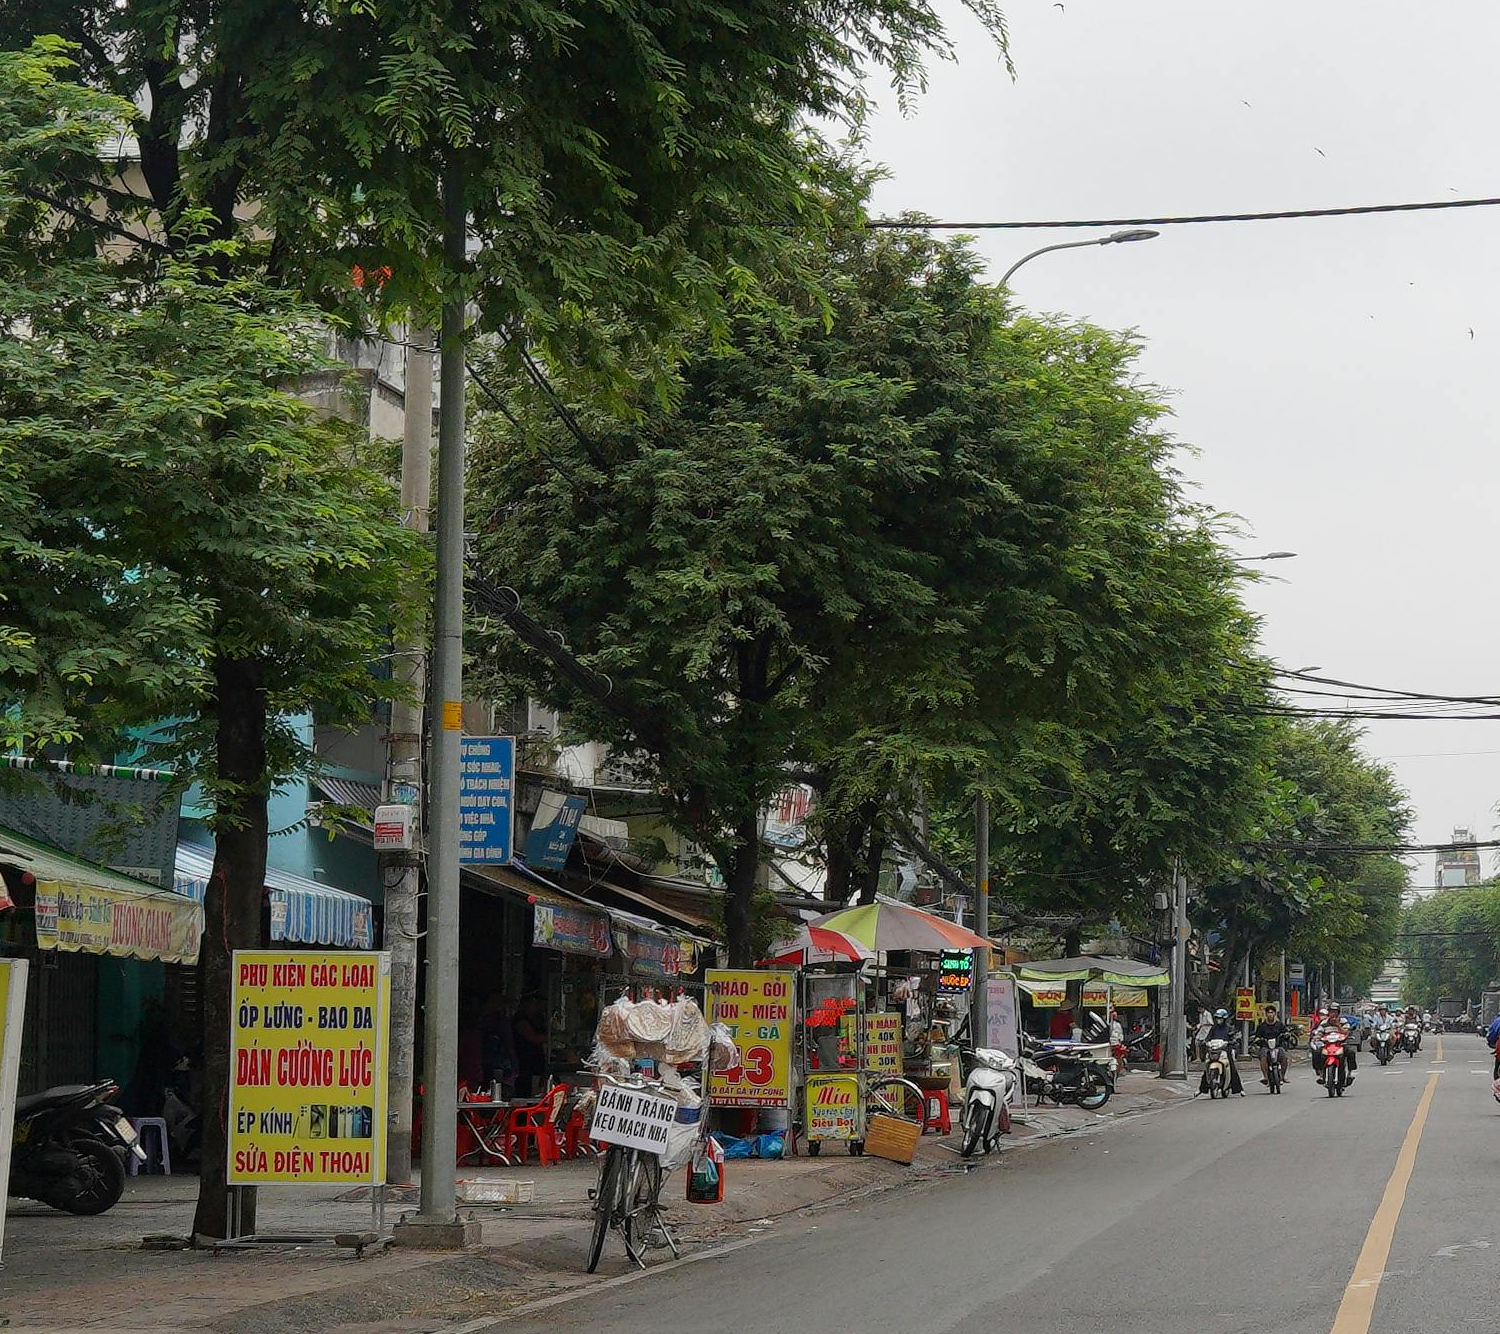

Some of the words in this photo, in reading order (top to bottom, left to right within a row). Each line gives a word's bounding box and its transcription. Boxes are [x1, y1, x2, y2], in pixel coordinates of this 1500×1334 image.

[239, 963, 267, 993] PHỤ
[272, 958, 306, 993] KIỆN
[310, 959, 338, 987] CÁC
[341, 963, 375, 993] LOẠI
[239, 997, 259, 1028] ỐP
[263, 1000, 304, 1029] LƯNG
[317, 1006, 348, 1029] BAO
[352, 1006, 373, 1029] DA
[237, 1039, 272, 1086] DÁN
[277, 1038, 334, 1087] CƯỜNG
[339, 1040, 372, 1096] LỰC
[237, 1109, 256, 1134] ÉP
[600, 1088, 633, 1113] BÁNH
[635, 1098, 675, 1122] TRÁNG
[594, 1111, 616, 1133] KẸO
[616, 1117, 648, 1139] MẠCH
[647, 1124, 668, 1144] NHA
[235, 1142, 268, 1173] SỬA
[274, 1145, 314, 1178] ĐIỆN
[320, 1151, 370, 1178] THOẠI
